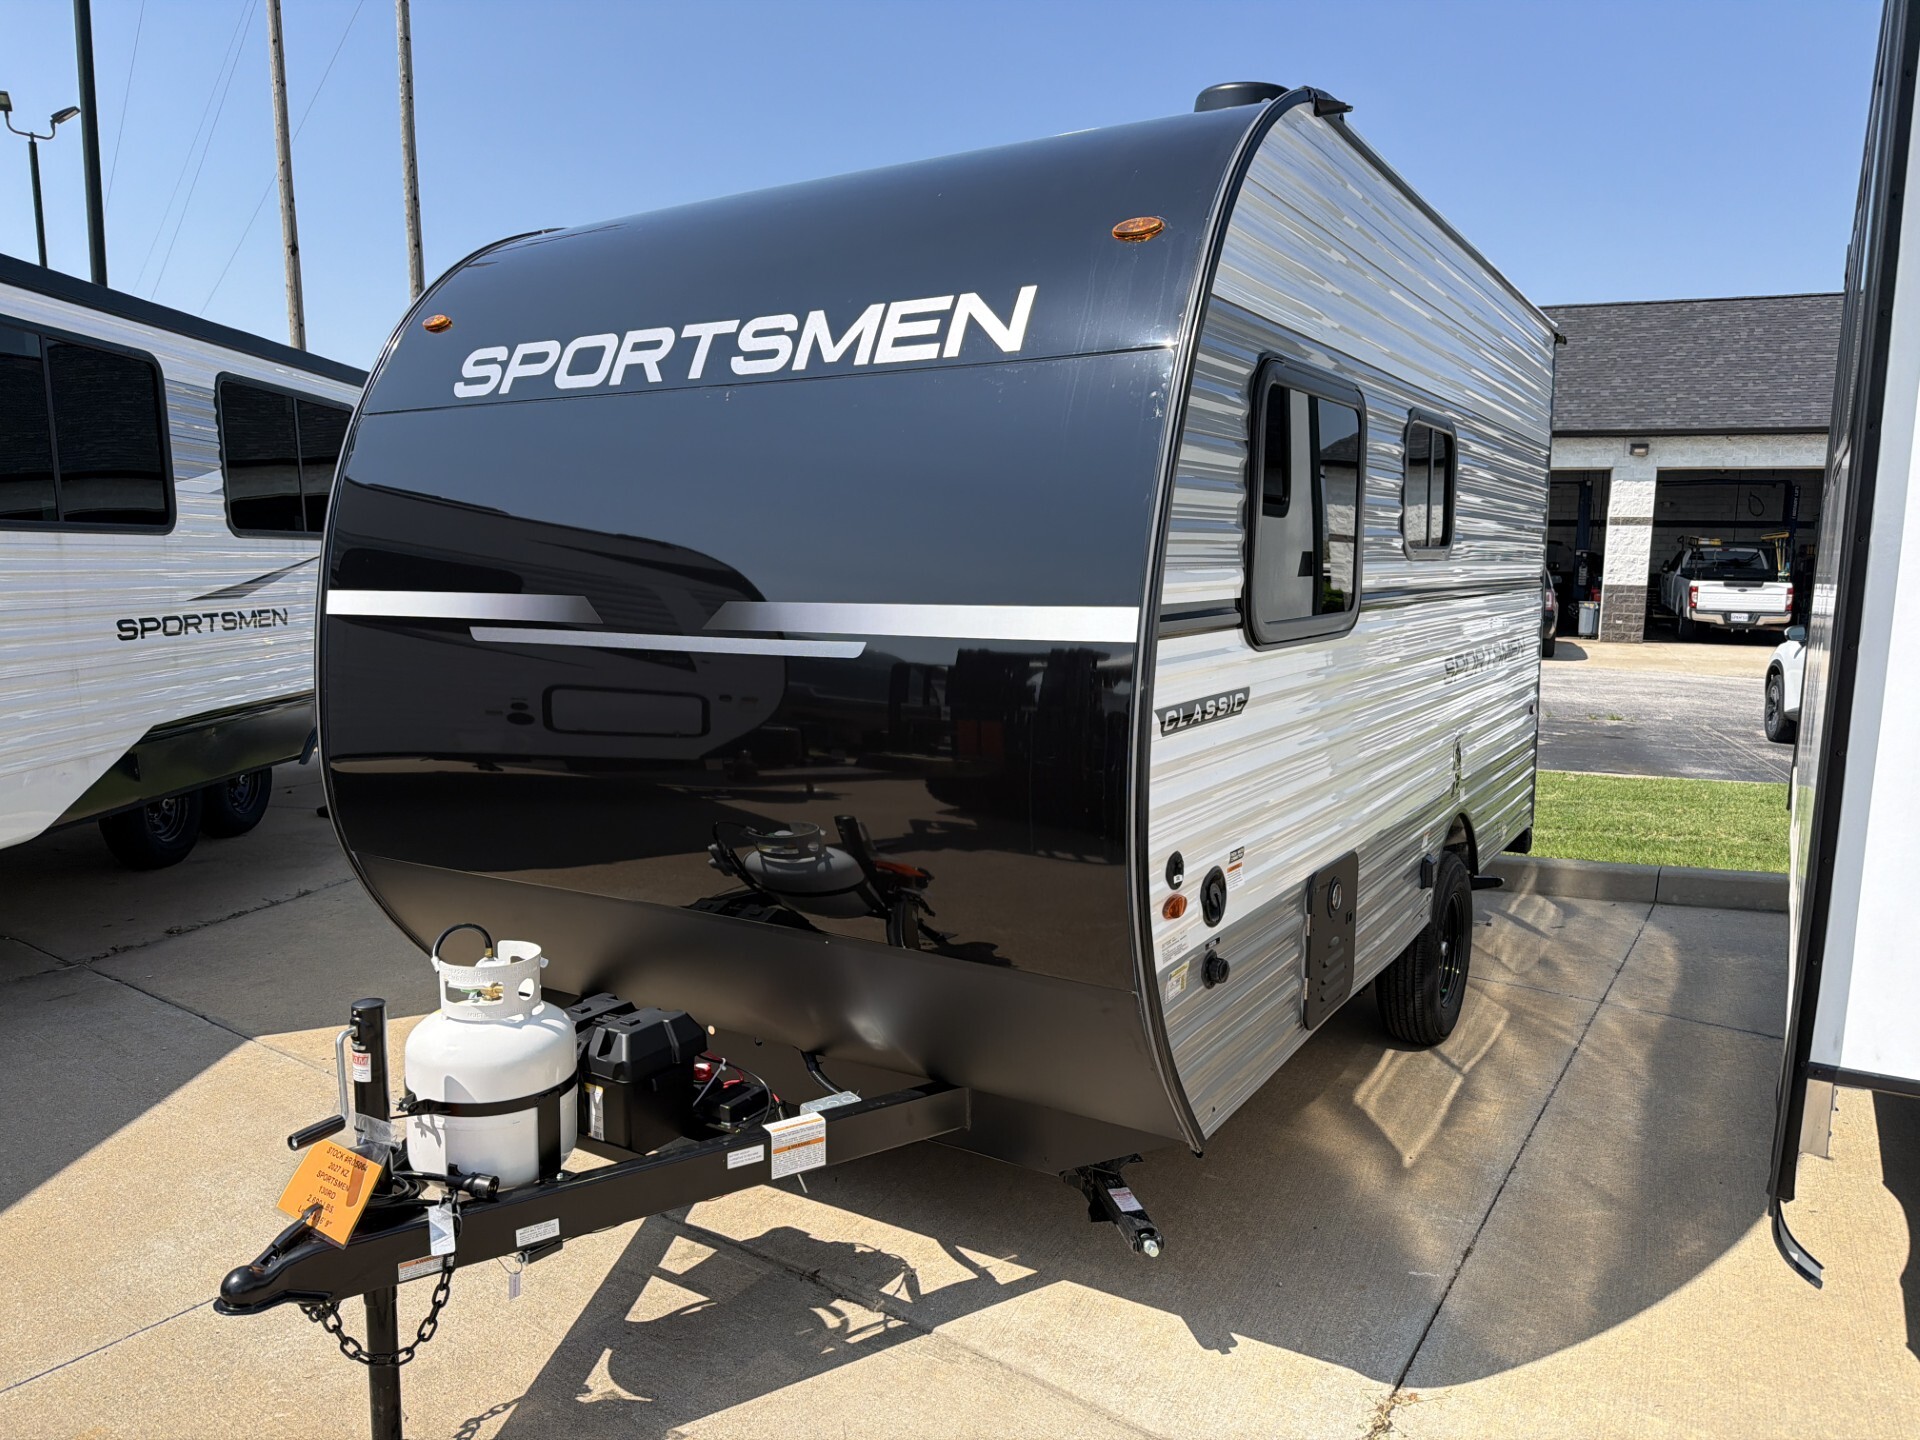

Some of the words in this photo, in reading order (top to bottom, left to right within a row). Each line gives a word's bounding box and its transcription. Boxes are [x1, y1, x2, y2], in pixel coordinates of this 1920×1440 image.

[453, 285, 1037, 398] SPORTSMEN
[116, 608, 288, 641] SPORTSMEN
[1163, 692, 1245, 732] CLASSIC
[326, 1146, 345, 1161] STOCK
[316, 1170, 350, 1192] SPORTSMEN
[328, 1162, 341, 1173] 2027
[341, 1168, 350, 1178] KZ
